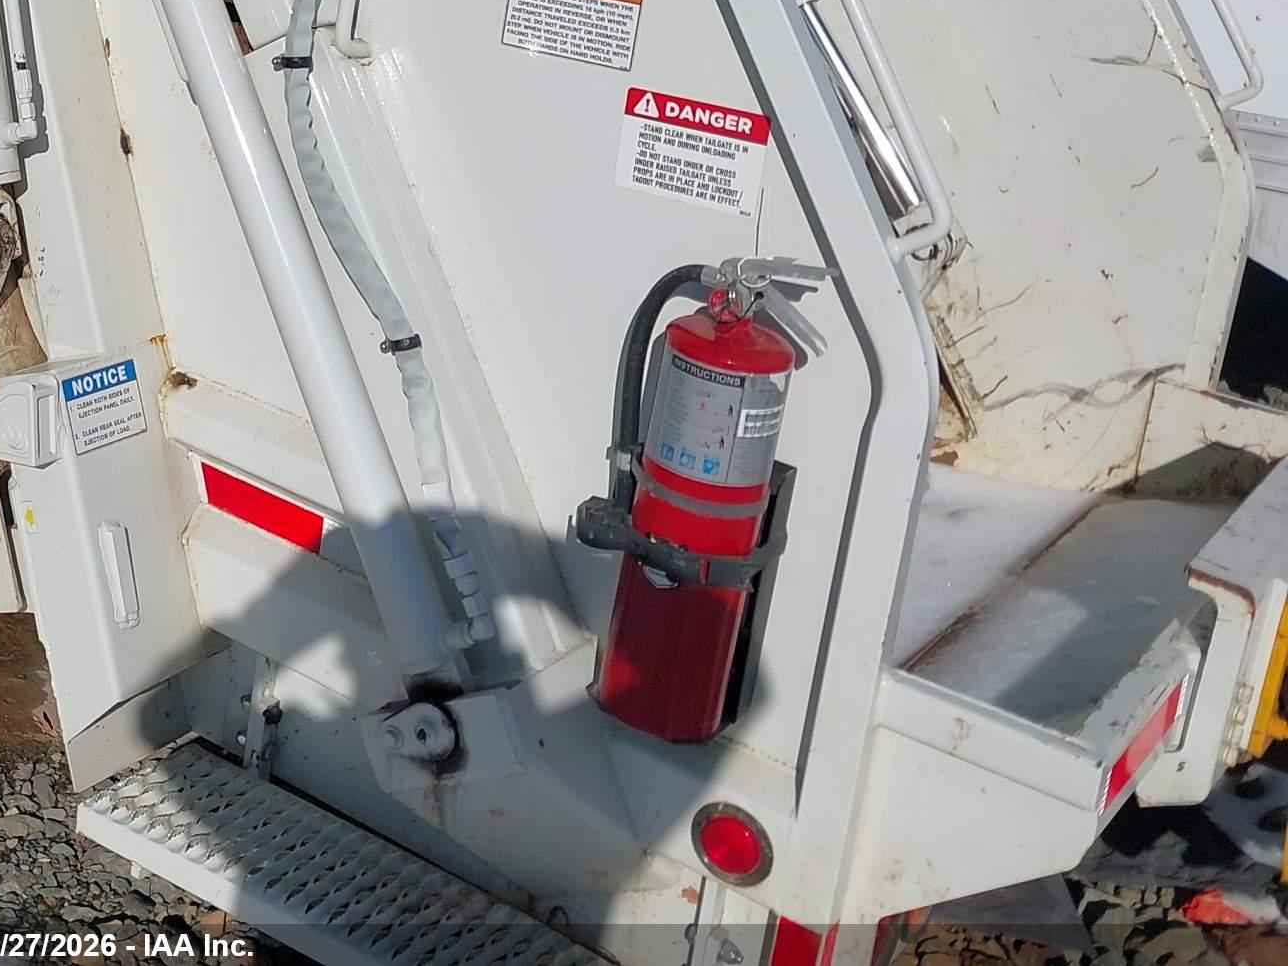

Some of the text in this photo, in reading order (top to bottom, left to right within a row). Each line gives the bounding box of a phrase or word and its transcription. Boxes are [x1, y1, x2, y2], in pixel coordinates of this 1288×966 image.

[511, 6, 542, 17] DISTANCE
[544, 13, 576, 24] TRAVELED
[577, 20, 608, 31] EXCEEDS
[517, 0, 552, 12] OPERATING
[606, 18, 627, 27] WHEN
[599, 0, 619, 9] WHEN
[620, 4, 634, 12] THE
[506, 28, 528, 38] FACING
[543, 36, 557, 44] SIDE
[569, 41, 582, 49] THE
[583, 44, 610, 55] VEHICLE
[611, 50, 629, 59] WITH
[507, 20, 521, 28] STEP
[523, 24, 541, 32] WHEN
[542, 28, 569, 38] VEHICLE
[615, 43, 631, 51] RIDE
[544, 20, 557, 28] NOT
[558, 23, 582, 33] MOUNT
[583, 28, 593, 36] OR
[594, 31, 629, 43] DISMOUNT
[664, 100, 753, 135] DANGER
[638, 131, 736, 160] MOTION AND DURING UNLOADING
[664, 128, 684, 139] CLEAR
[685, 133, 703, 143] WHEN
[704, 137, 732, 150] TAILGATE
[733, 144, 740, 152] IS
[741, 145, 749, 154] IN
[634, 157, 731, 187] UNDER RAISED TAILGATE UNLESS
[648, 151, 660, 161] NOT
[662, 155, 681, 166] STAND
[683, 159, 703, 171] UNDER
[705, 164, 714, 173] OR
[715, 167, 736, 179] CROSS
[631, 175, 653, 186] TAGOUT
[654, 180, 693, 196] PROCEDURES
[695, 190, 707, 199] ARE
[709, 193, 716, 201] IN
[633, 166, 653, 178] PROPS
[654, 171, 667, 181] ARE
[667, 174, 674, 183] IN
[675, 176, 695, 187] PLACE
[696, 180, 709, 191] AND
[710, 184, 738, 197] LOCKOUT
[71, 364, 128, 396] NOTICE
[674, 356, 742, 387] INSTRUCTIONS
[76, 398, 93, 410] CLEAN
[93, 394, 107, 404] BOTH
[108, 389, 122, 400] SIDES
[123, 387, 130, 395] OF
[78, 405, 102, 419] EJECTION
[103, 400, 119, 411] PANEL
[81, 424, 98, 437] CLEAN
[98, 420, 113, 432] REAR
[113, 416, 126, 427] SEAL
[126, 410, 142, 423] AFTER
[83, 432, 108, 446] EJECTION
[108, 429, 116, 438] OF
